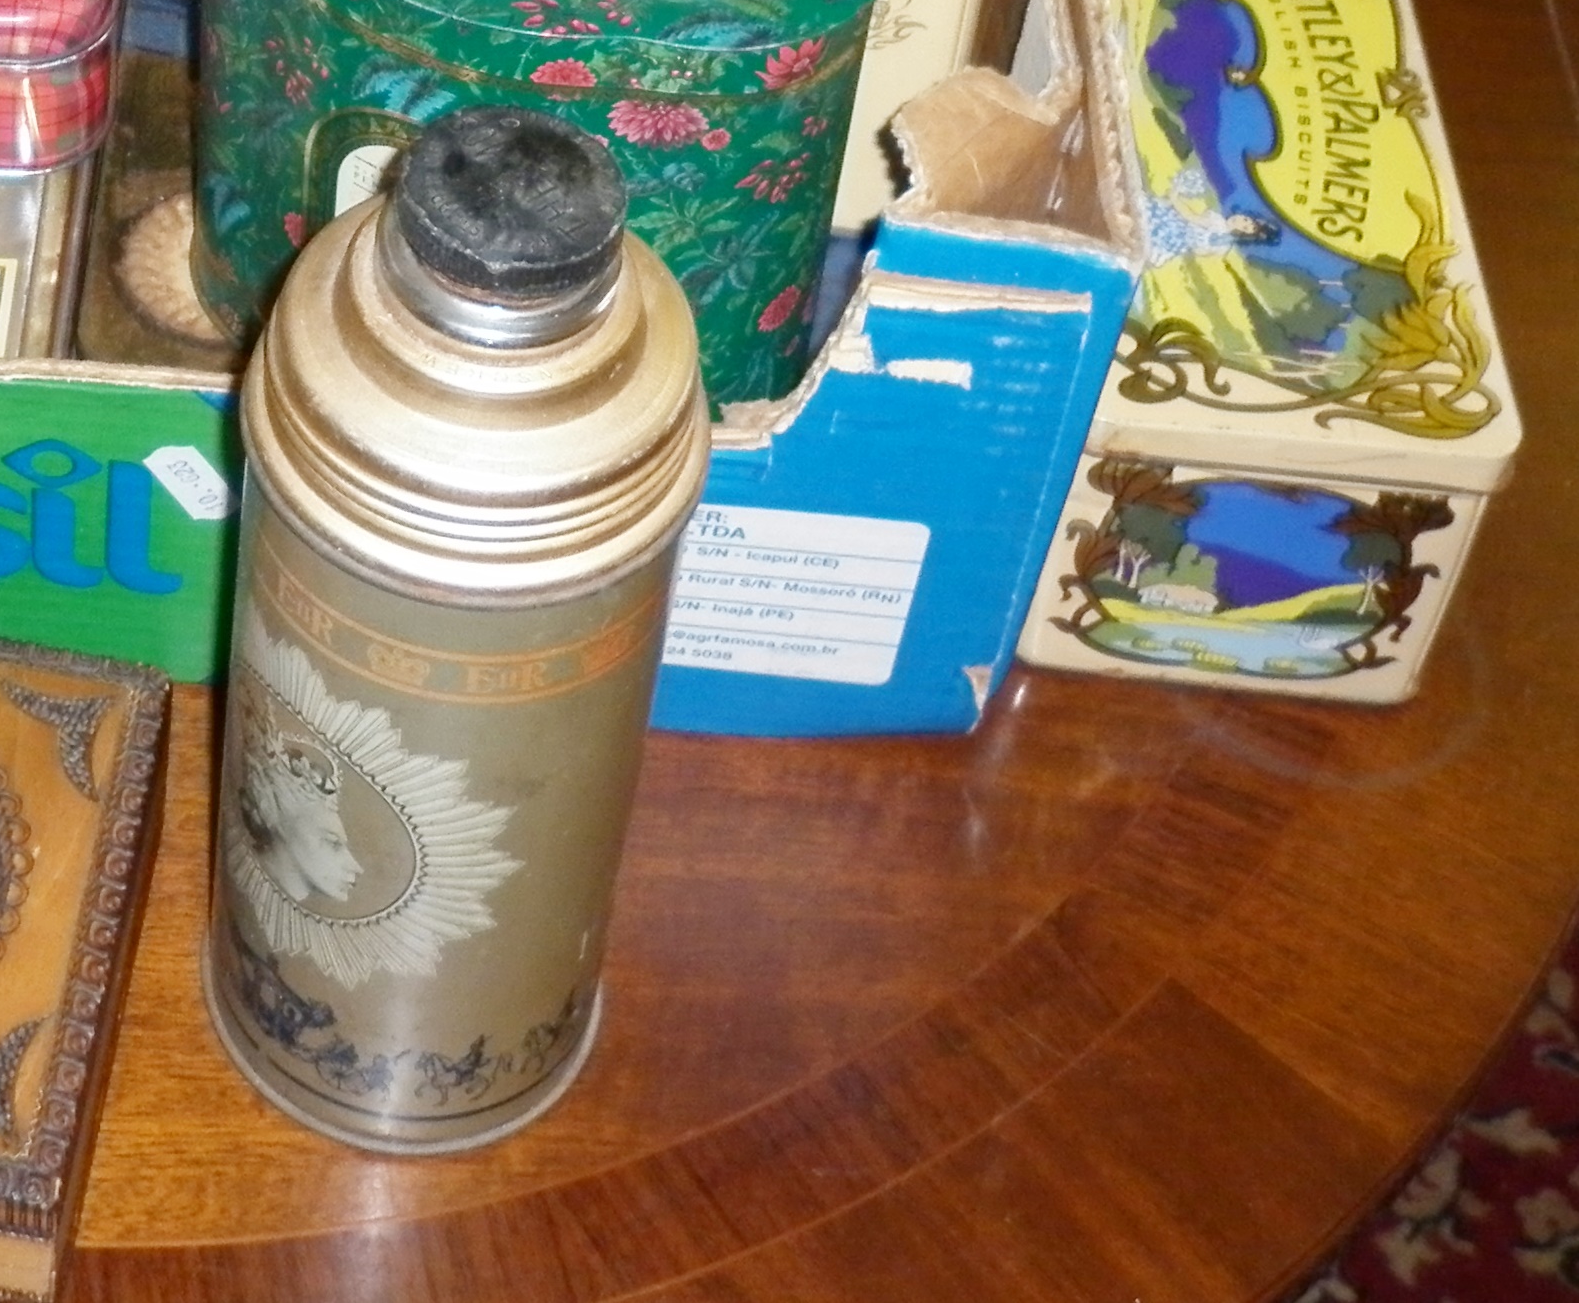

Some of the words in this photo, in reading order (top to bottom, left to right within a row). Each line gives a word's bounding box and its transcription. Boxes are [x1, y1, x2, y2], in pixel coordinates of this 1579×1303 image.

[1290, 82, 1312, 209] BISCUITS
[695, 510, 728, 523] ER:
[688, 524, 746, 540] TDA
[697, 547, 729, 558] S/N
[804, 555, 839, 570] (CE)
[688, 573, 735, 586] Rural
[861, 589, 901, 604] (RN)
[759, 610, 794, 621] (PE)
